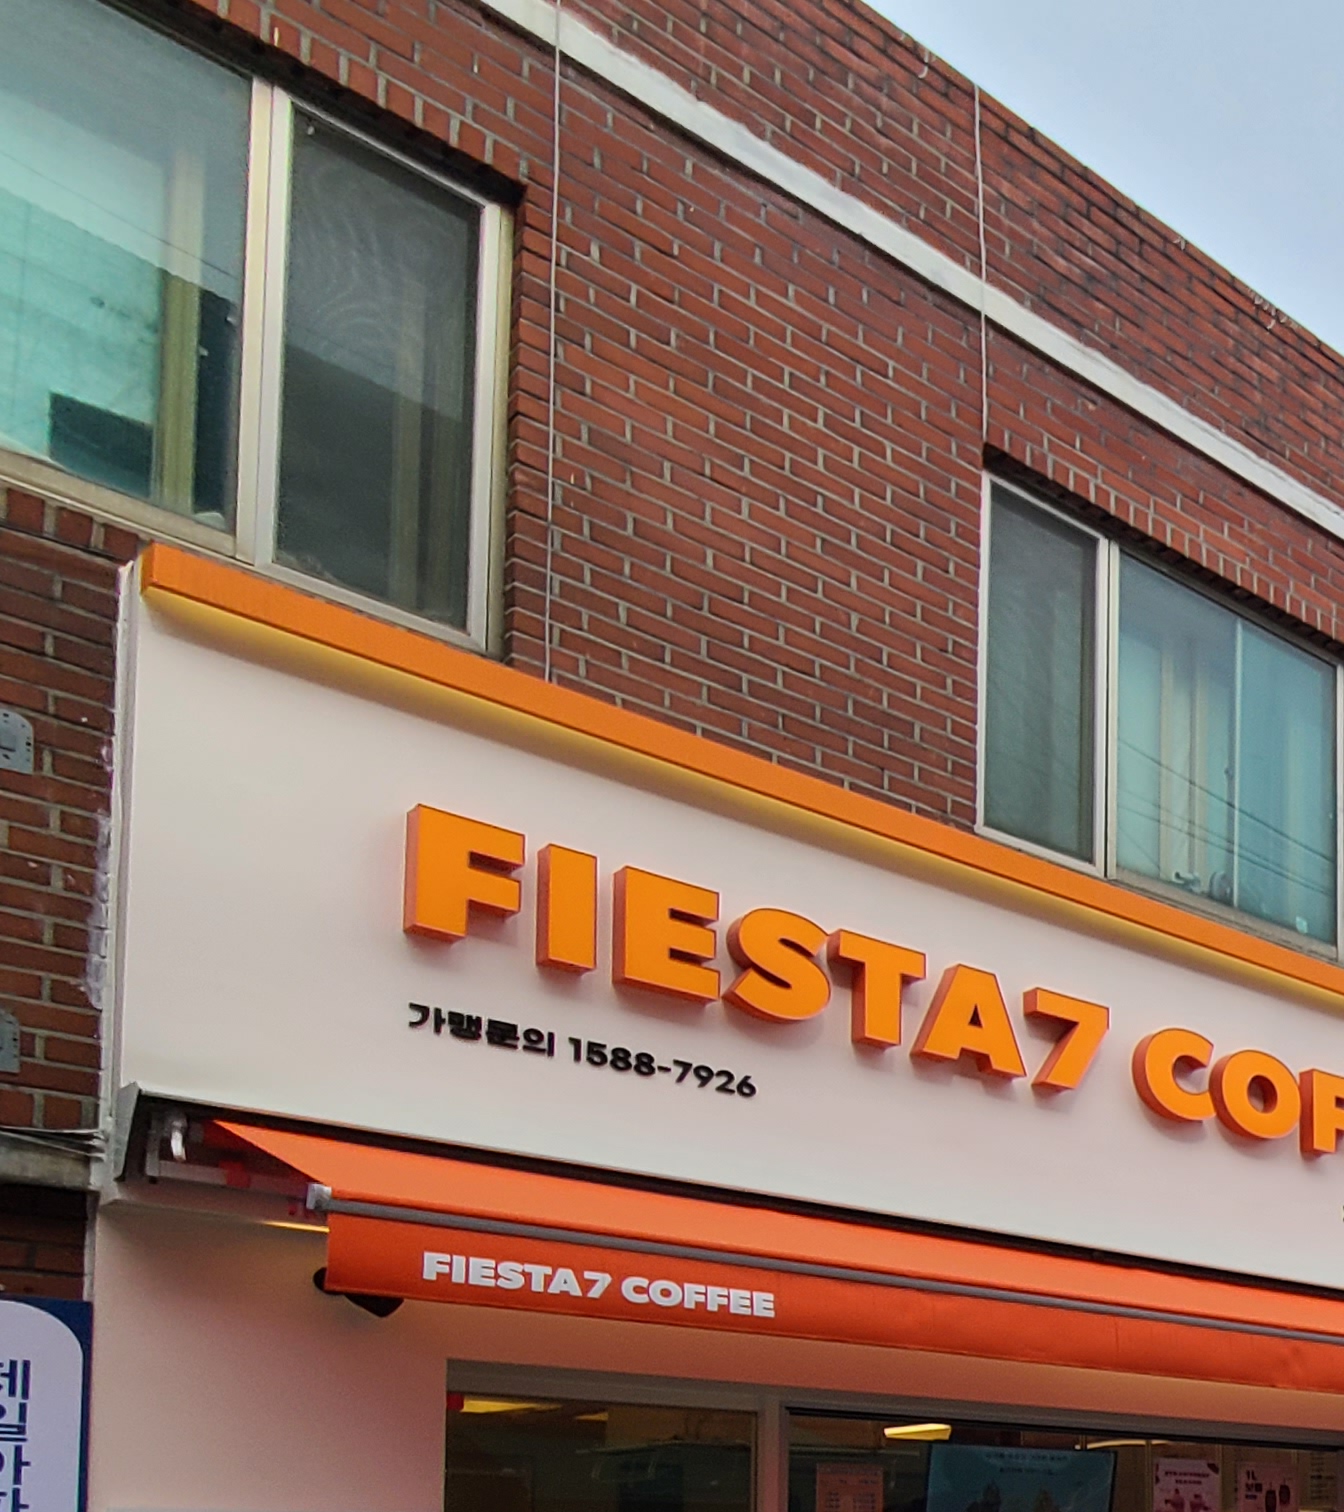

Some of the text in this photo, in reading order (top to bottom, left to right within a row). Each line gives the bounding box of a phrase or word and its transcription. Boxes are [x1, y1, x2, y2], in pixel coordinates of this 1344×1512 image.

[403, 803, 1110, 1091] FIESTA7
[408, 1003, 758, 1100] 가맹문의 1588-7926
[421, 1251, 777, 1319] FIESTA7 COFFEE
